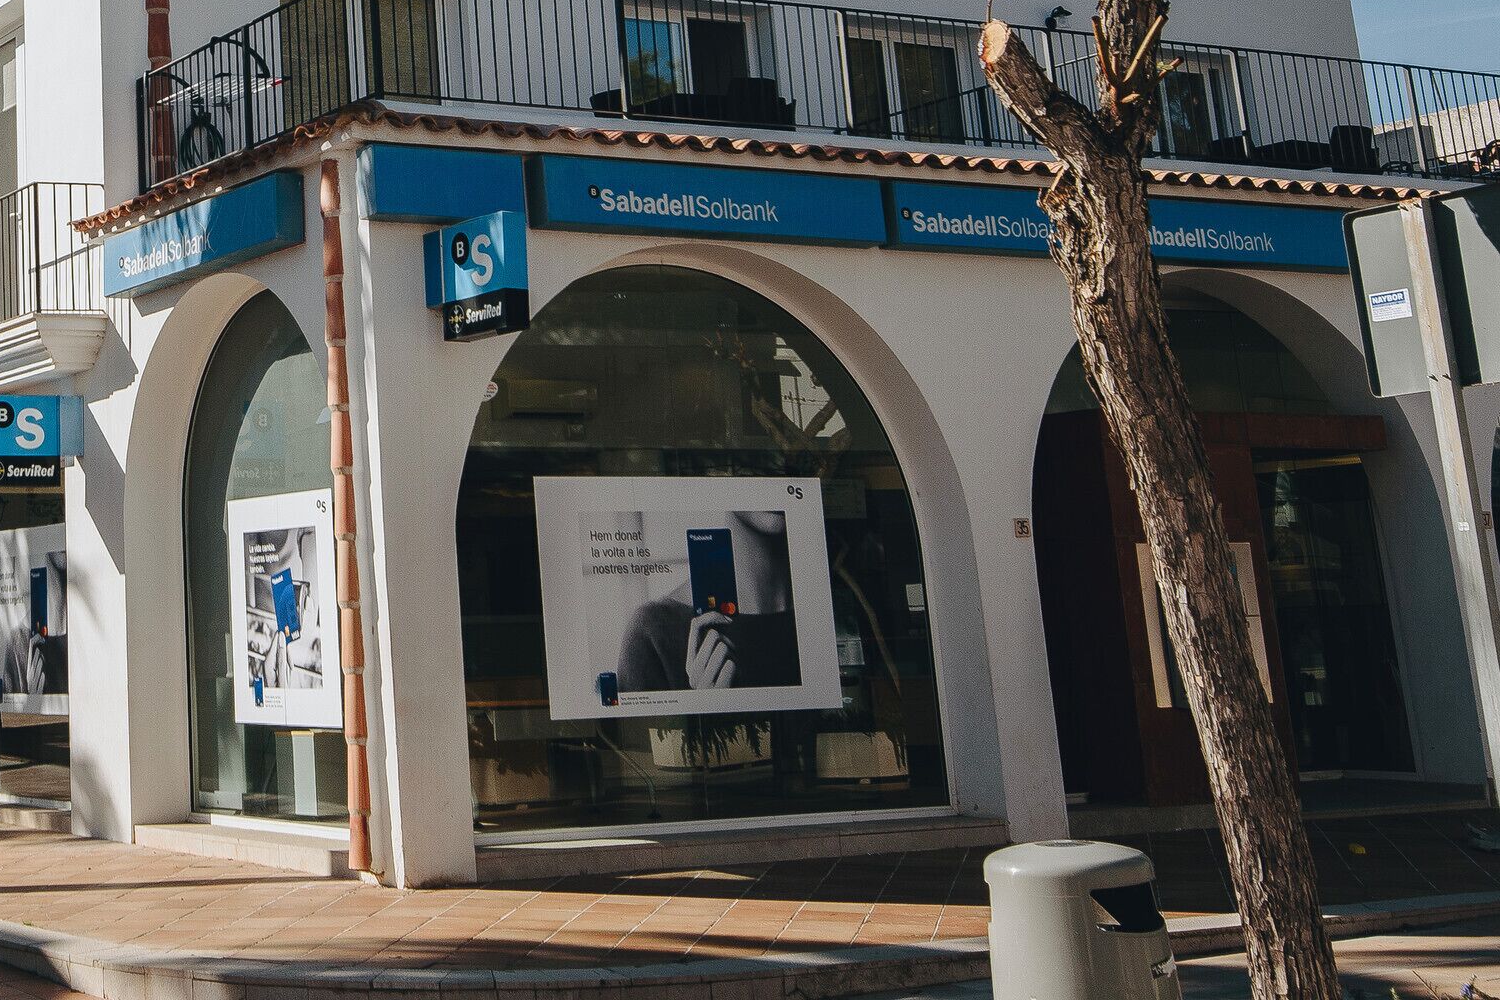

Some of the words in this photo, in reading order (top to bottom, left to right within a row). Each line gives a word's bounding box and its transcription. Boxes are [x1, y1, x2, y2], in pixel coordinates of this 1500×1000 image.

[600, 188, 779, 222] SabadellSolbank
[913, 211, 1049, 239] SabadellSolba
[1150, 225, 1275, 252] badellSolbank
[456, 241, 465, 257] B
[471, 234, 493, 286] S
[1371, 293, 1404, 304] NAYBOR
[466, 302, 502, 324] ServiRed
[15, 408, 45, 450] S
[7, 464, 54, 478] ServiRed
[590, 530, 612, 542] Hem
[615, 530, 642, 542] donat
[1017, 520, 1029, 535] 35
[591, 547, 600, 558] la
[603, 546, 626, 558] volta
[627, 549, 634, 558] a
[635, 546, 651, 558] les
[592, 564, 629, 575] nostres
[631, 563, 673, 577] targetes.
